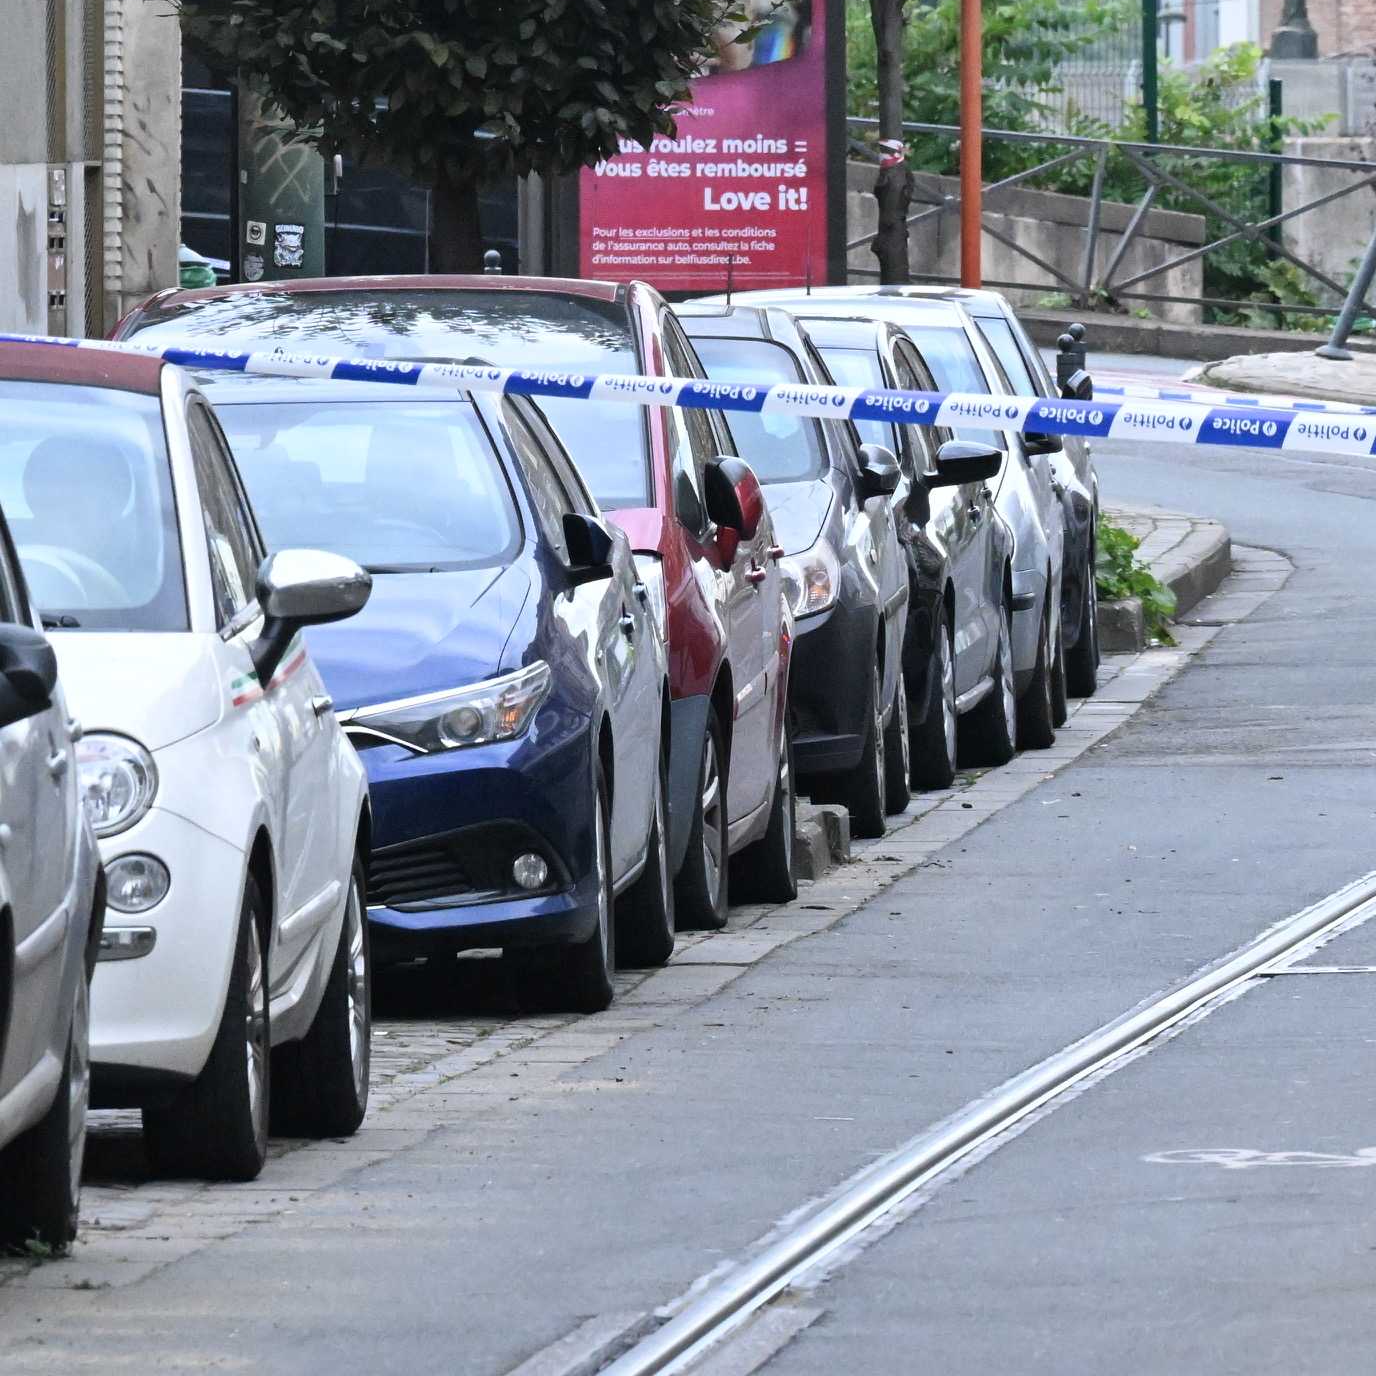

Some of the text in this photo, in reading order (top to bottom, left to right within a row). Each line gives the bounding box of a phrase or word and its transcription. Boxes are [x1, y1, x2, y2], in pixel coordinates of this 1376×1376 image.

[618, 138, 646, 154] us
[650, 134, 717, 154] roulez
[722, 134, 788, 154] moins
[595, 158, 808, 178] Vous êtes remboursé
[704, 184, 808, 212] Love it!
[592, 227, 777, 238] Pour les exclusions et les conditions
[592, 240, 775, 253] de l'assurance auto, consultez la fiche
[592, 254, 752, 266] d'information sur belfiusdirec.be.
[433, 364, 482, 379] Politie
[521, 371, 570, 387] Police
[604, 377, 655, 393] Politie
[693, 383, 741, 400] Police
[776, 390, 827, 407] Politie
[865, 395, 912, 412] Police
[950, 402, 1001, 418] Politie
[1039, 407, 1085, 423] Police
[1123, 412, 1175, 430] Politie
[1213, 417, 1259, 434] Police
[1298, 423, 1350, 441] Politie
